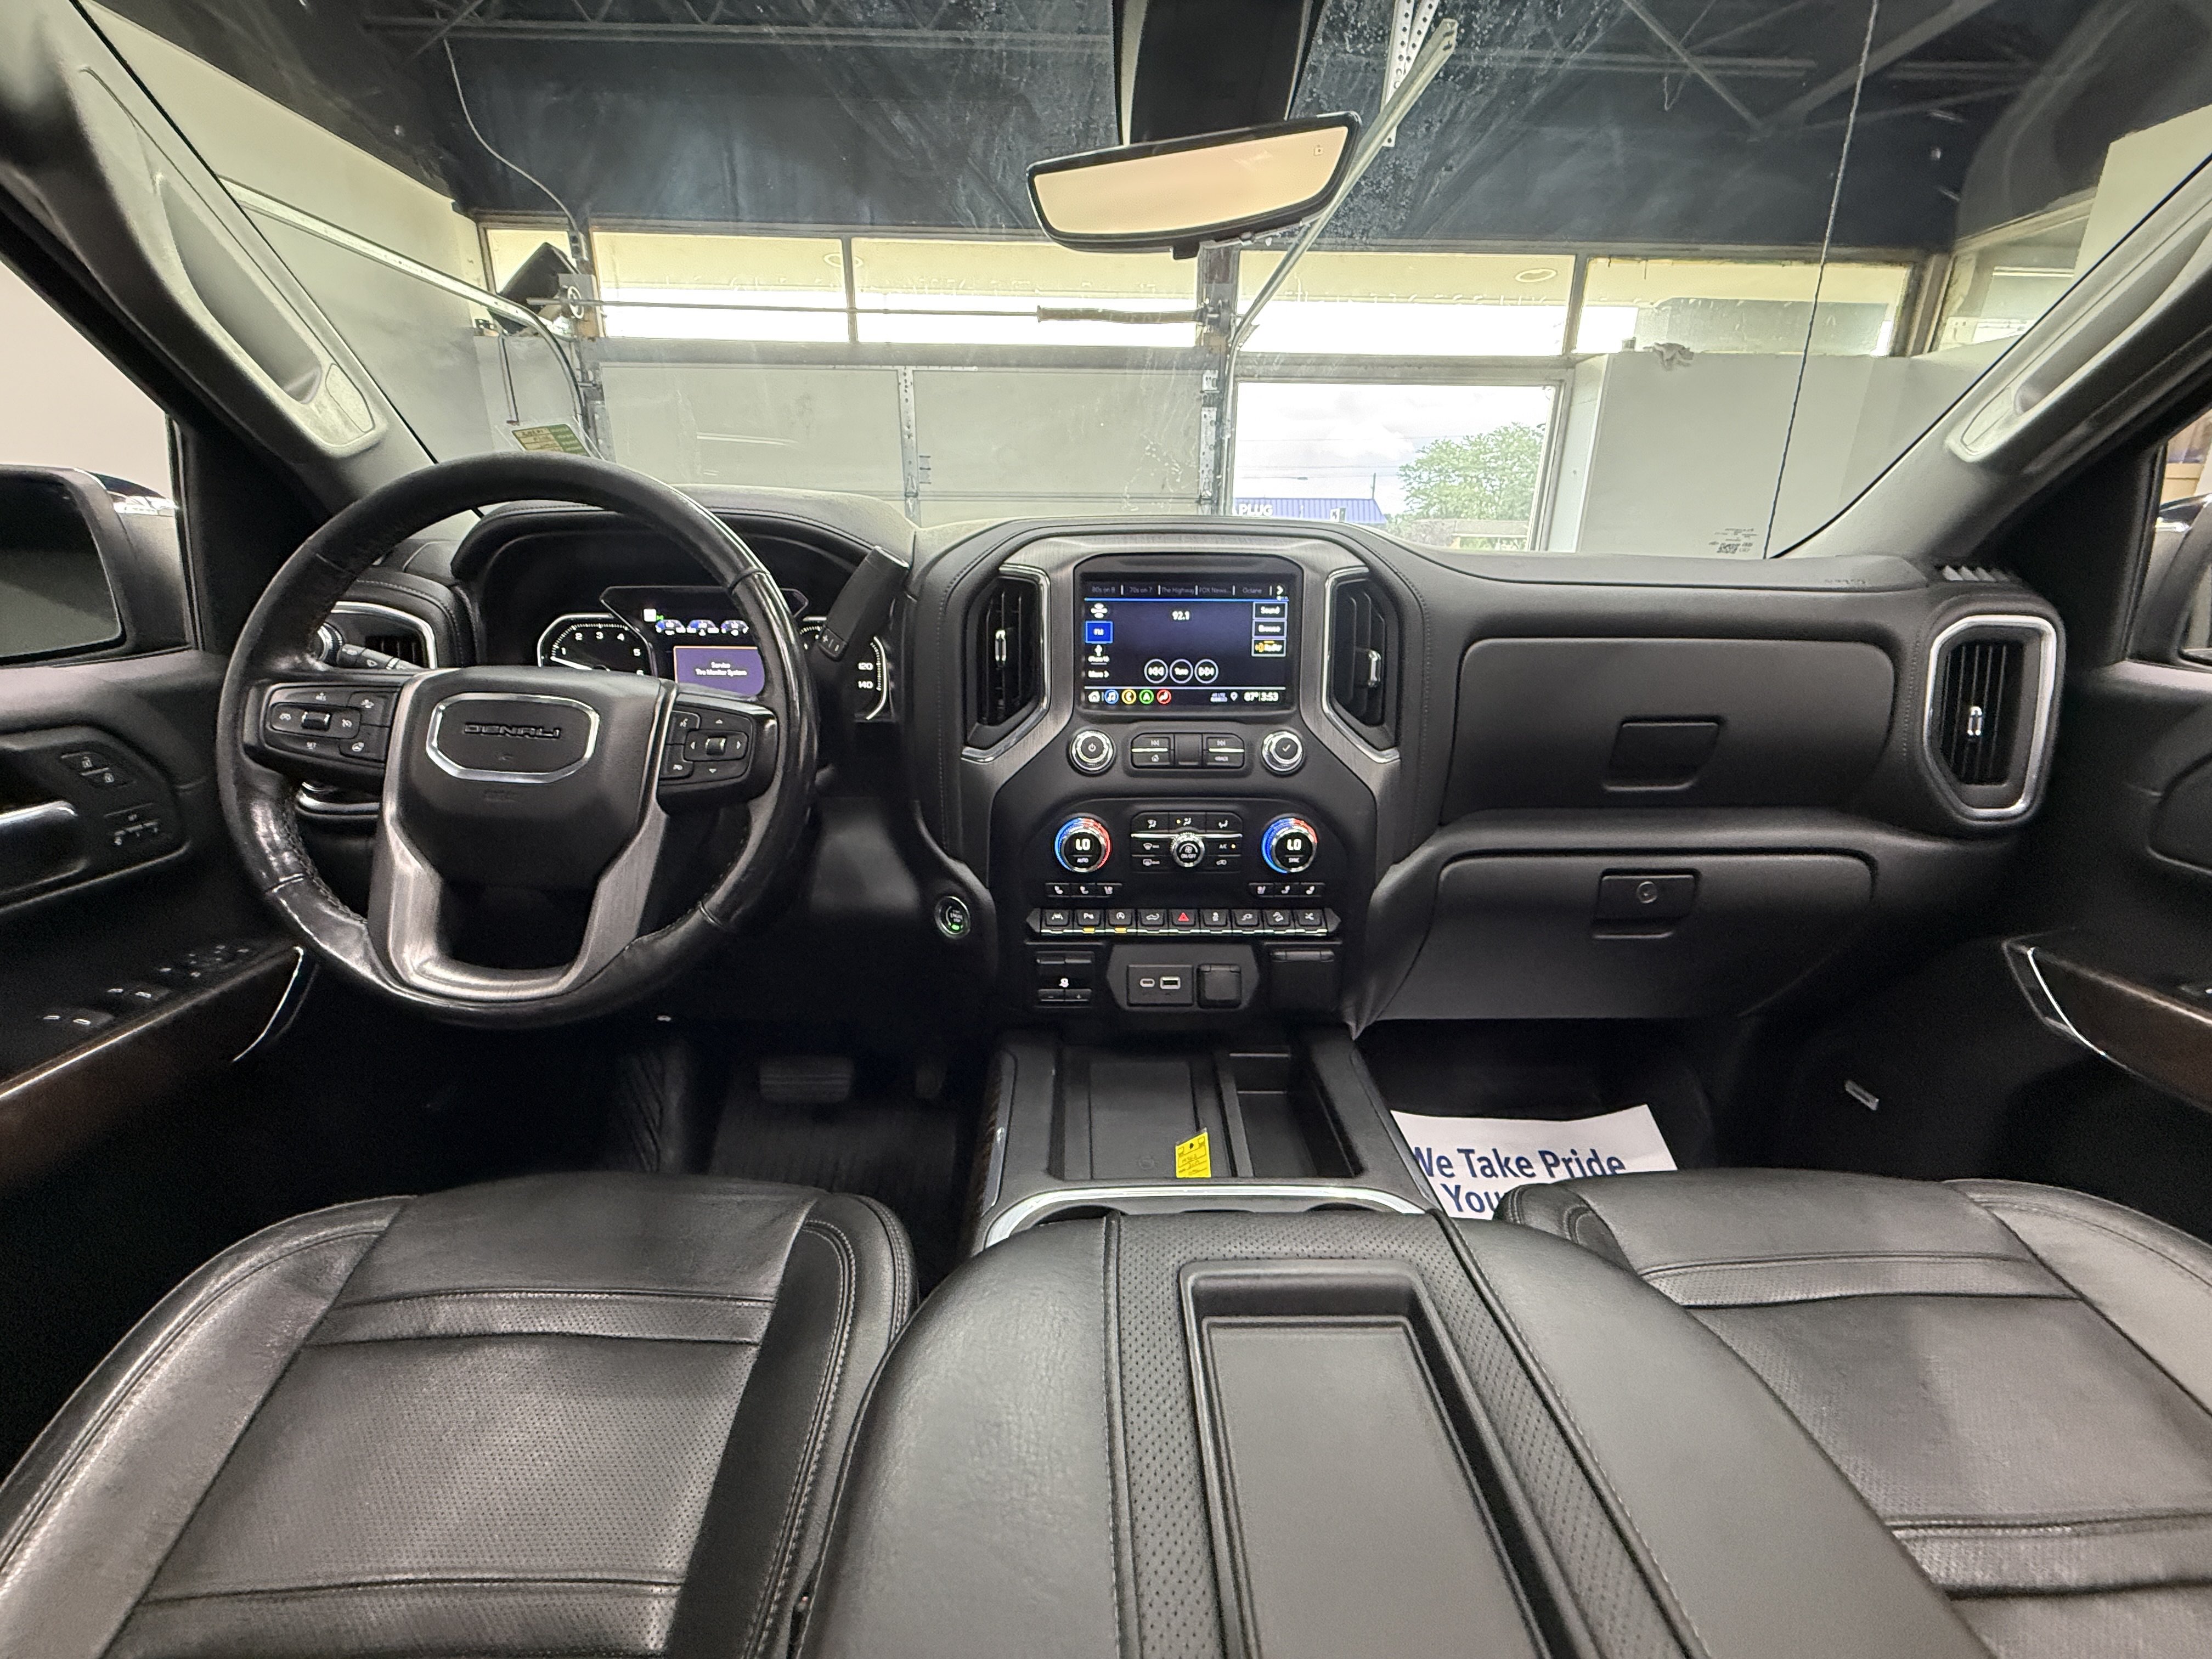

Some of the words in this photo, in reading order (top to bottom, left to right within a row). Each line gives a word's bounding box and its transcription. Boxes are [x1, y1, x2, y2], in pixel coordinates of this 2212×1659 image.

[1239, 504, 1273, 516] PLUG
[1172, 610, 1190, 620] 92.1
[561, 647, 566, 655] 1
[633, 648, 641, 656] 5
[858, 662, 873, 670] 120
[858, 681, 873, 689] 140
[465, 724, 560, 738] DENALI
[1075, 838, 1091, 850] LO
[1286, 838, 1302, 850] LO
[1457, 1148, 1536, 1178] Take
[1538, 1148, 1626, 1178] Pride
